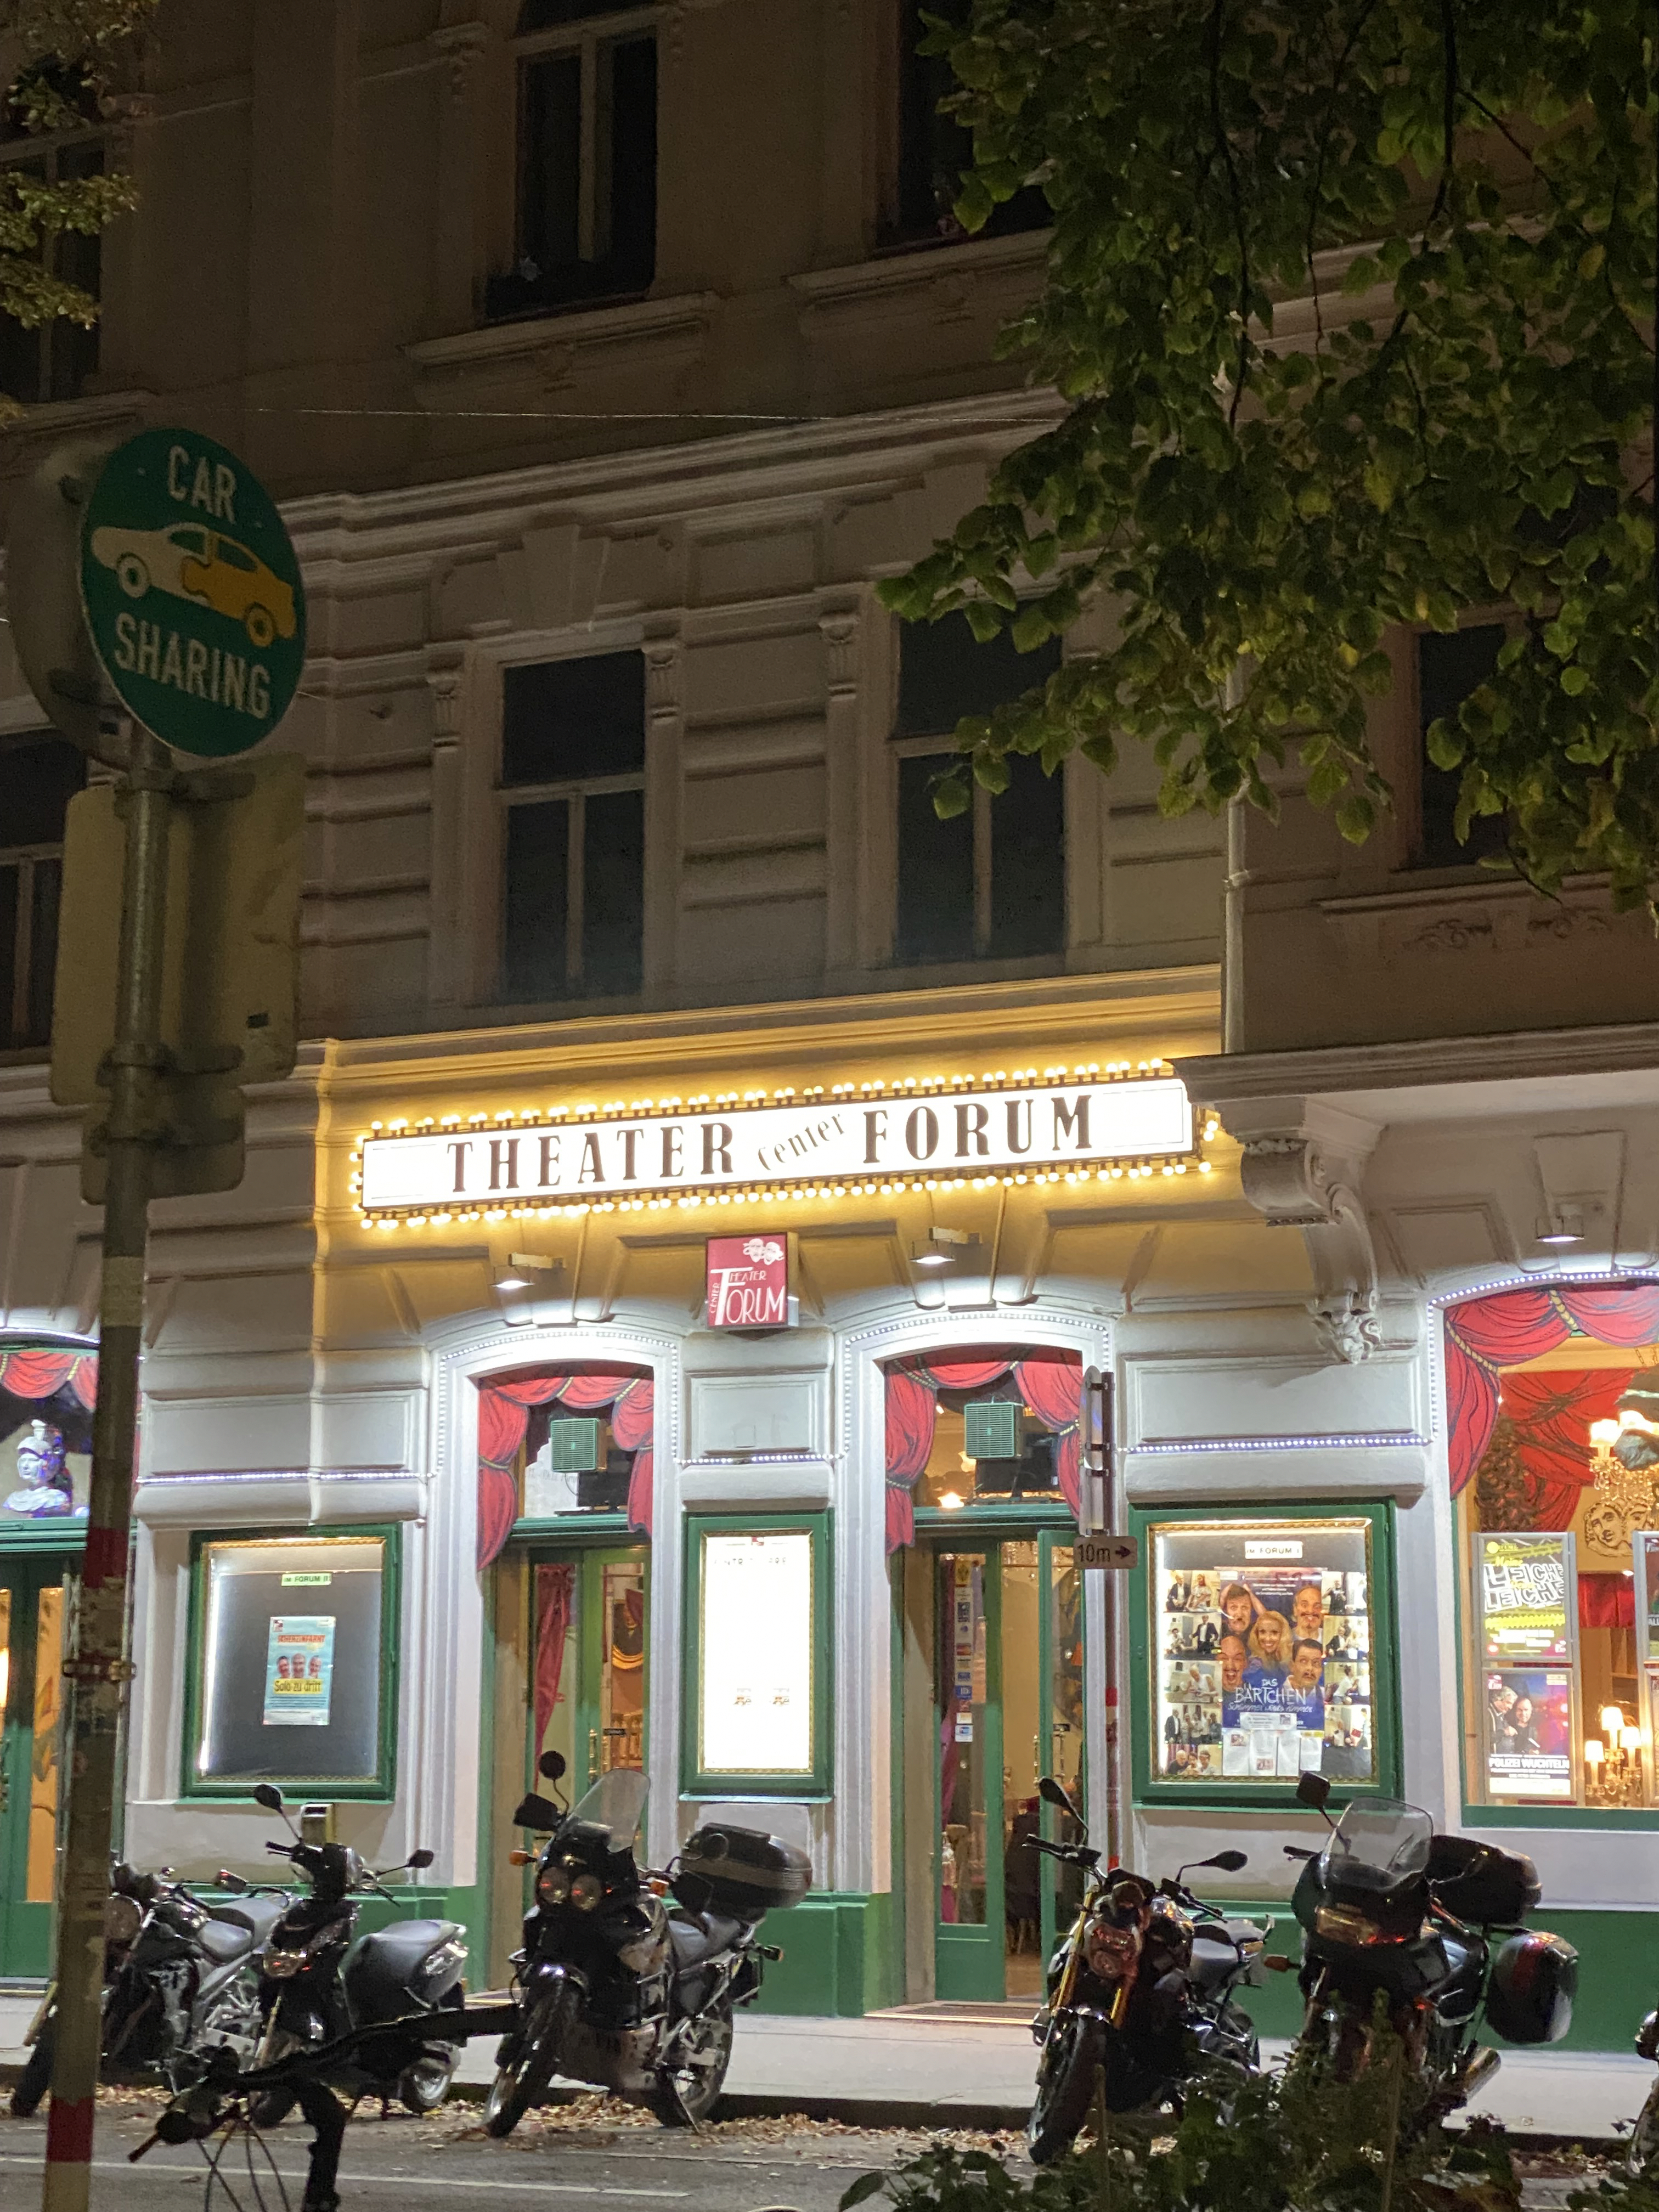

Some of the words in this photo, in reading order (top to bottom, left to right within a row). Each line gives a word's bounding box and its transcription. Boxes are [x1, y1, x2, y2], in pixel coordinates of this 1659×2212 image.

[168, 445, 237, 524] CAR
[114, 612, 271, 719] SHARING
[447, 1122, 734, 1193] THEATER
[863, 1094, 1092, 1164] FORUM
[709, 1283, 720, 1314] CENTER
[714, 1276, 786, 1325] FORUM
[1078, 1544, 1110, 1562] 10m
[294, 1683, 302, 1691] zu
[1234, 1682, 1306, 1705] BÄRTCHEN
[1261, 1678, 1278, 1687] DAS
[1489, 1758, 1521, 1768] POLIZEI
[1521, 1759, 1570, 1769] WUCHTELN
